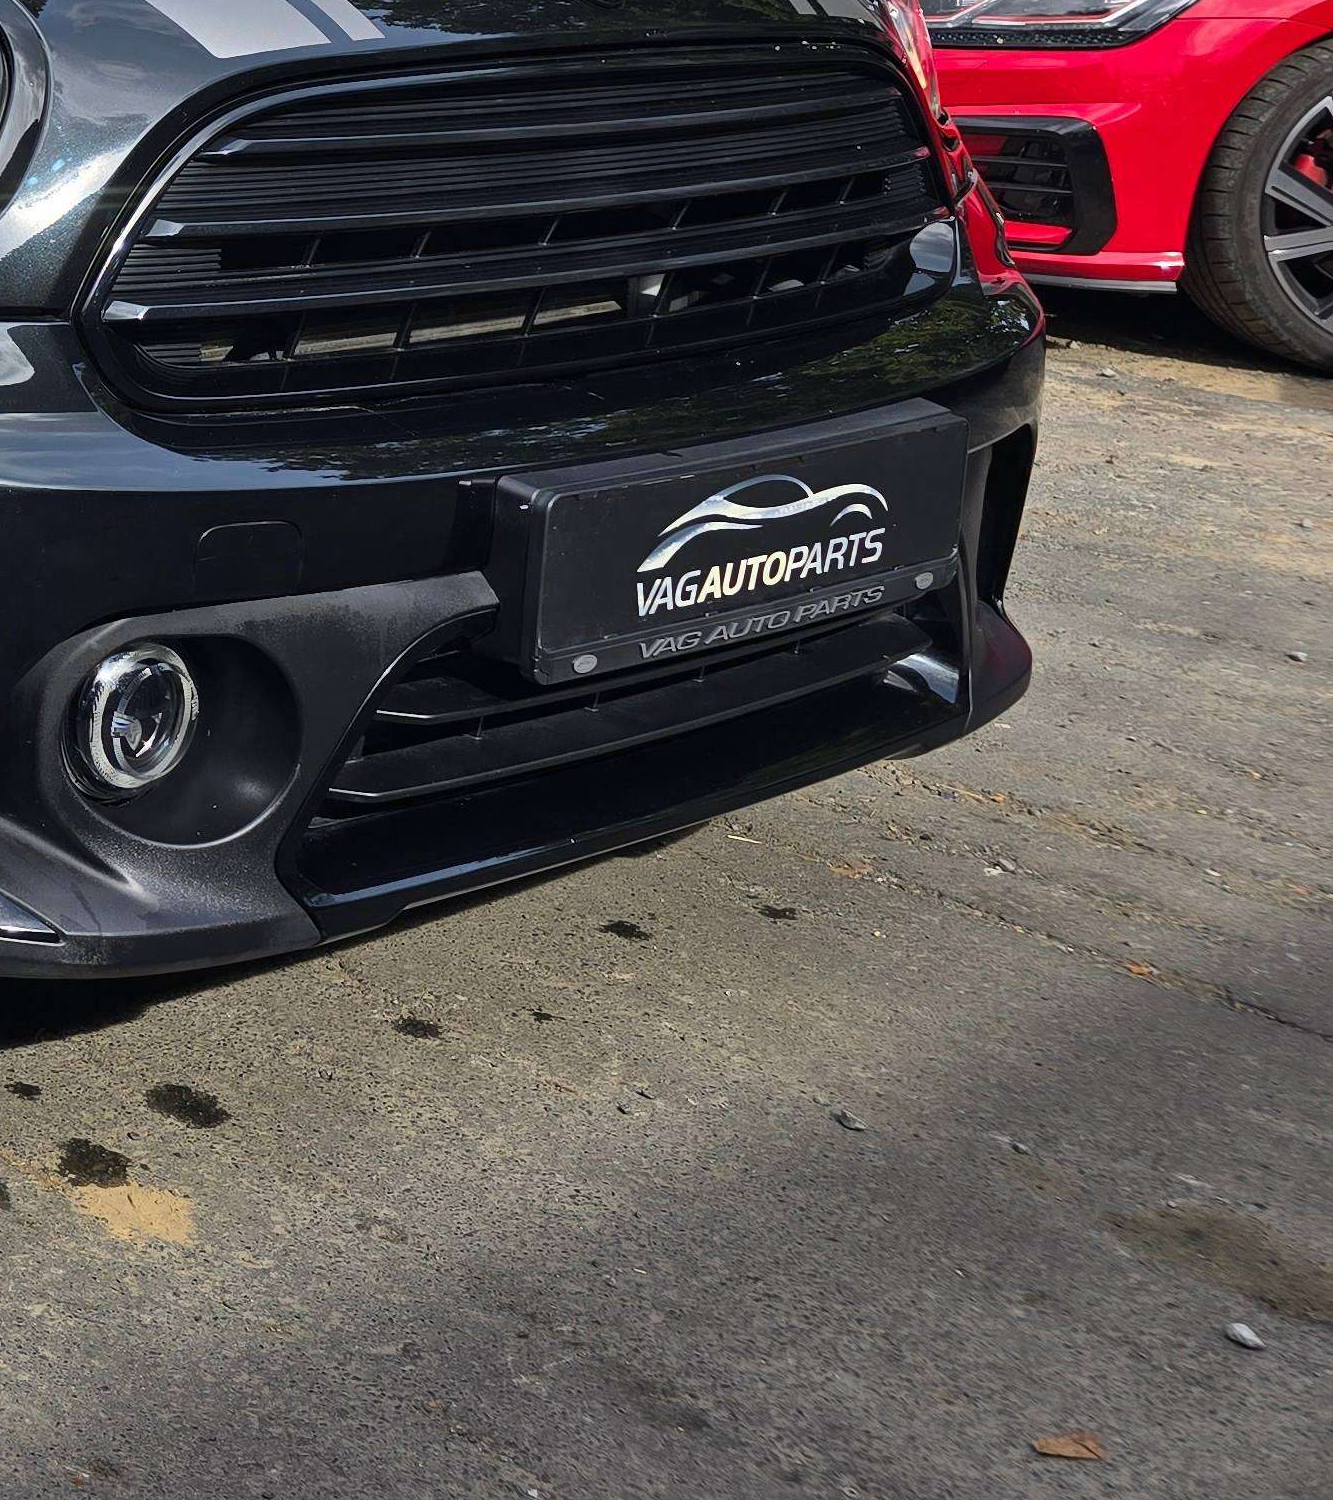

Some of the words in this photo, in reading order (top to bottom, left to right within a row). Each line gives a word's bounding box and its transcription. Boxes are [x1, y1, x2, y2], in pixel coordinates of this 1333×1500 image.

[636, 528, 885, 616] VAGAUTOPARTS
[639, 631, 701, 660] VAG
[705, 609, 790, 645] AUTO
[793, 585, 885, 623] PARTS
